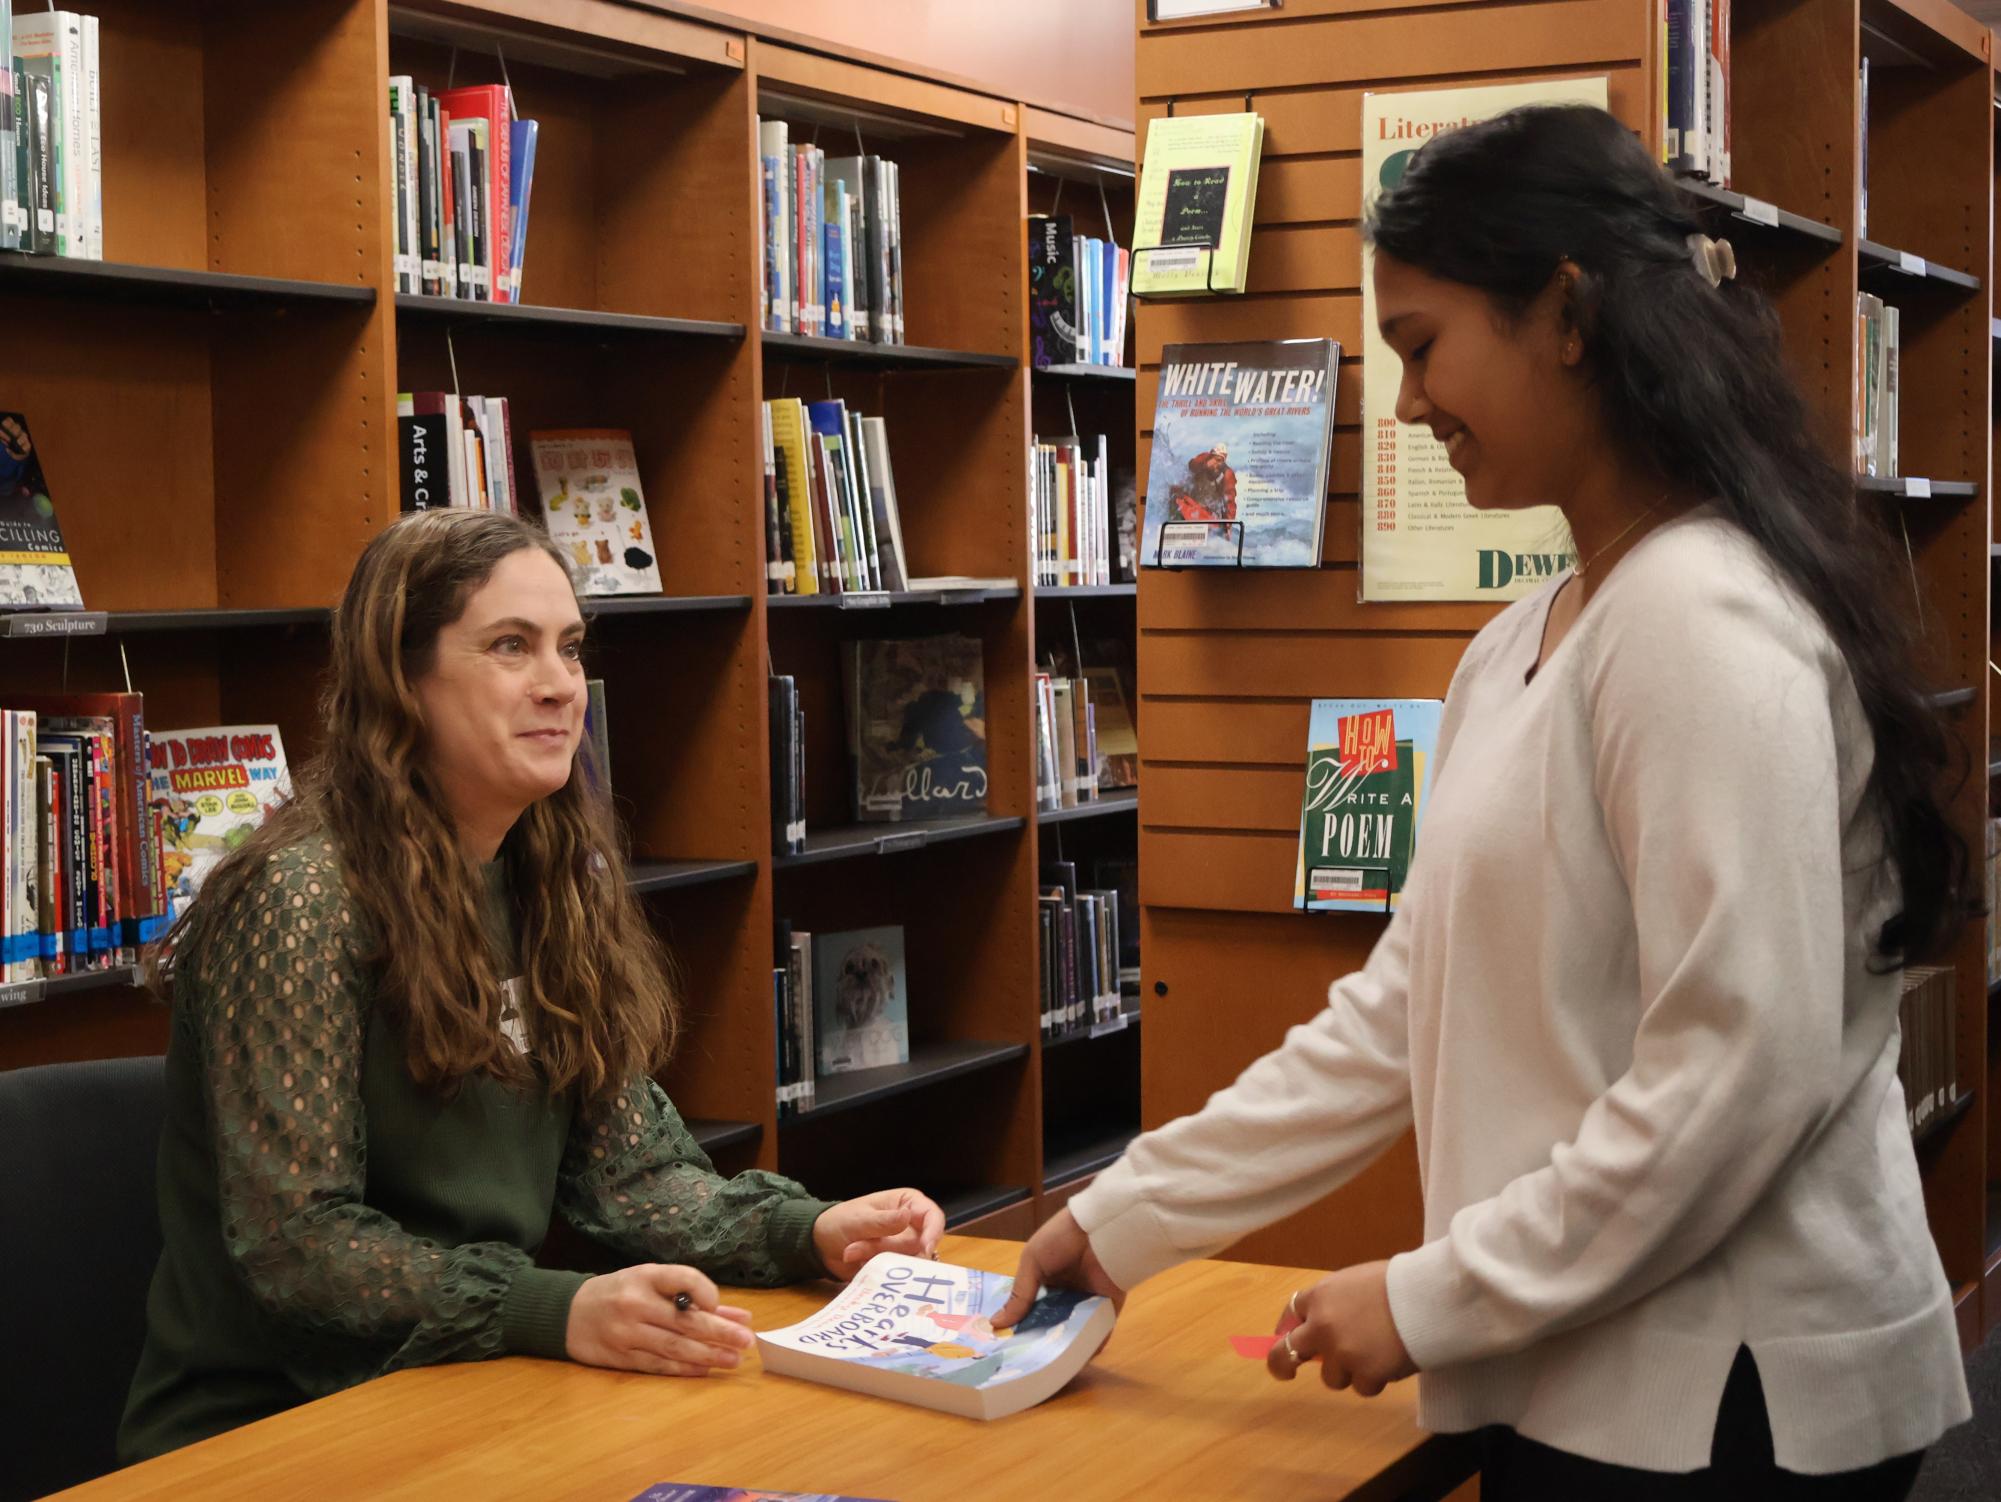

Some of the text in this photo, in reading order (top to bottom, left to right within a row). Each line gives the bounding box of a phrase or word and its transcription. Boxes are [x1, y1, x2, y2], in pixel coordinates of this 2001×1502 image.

[70, 109, 82, 157] Homes
[41, 154, 49, 183] House
[500, 163, 508, 178] OF
[41, 184, 49, 208] Ideas
[1045, 222, 1059, 264] Music
[1163, 361, 1325, 404] WHITE WATER!
[1158, 400, 1169, 408] THE
[1171, 399, 1191, 408] THRILL
[1194, 399, 1207, 408] AND
[1180, 406, 1311, 417] OF RUNNING THE WORLD'S GREAT RIVERS
[1377, 418, 1396, 428] 800
[1377, 430, 1396, 439] 810
[1377, 441, 1396, 451] 820
[1377, 453, 1396, 462] 830
[413, 425, 429, 513] Arts & Cr
[1377, 476, 1396, 485] 850
[1377, 488, 1396, 497] 860
[1377, 499, 1396, 509] 870
[1377, 511, 1396, 520] 880
[1377, 522, 1396, 532] 890
[28, 543, 64, 552] Comics
[1153, 549, 1172, 560] MRK
[1173, 549, 1198, 560] BLAINE
[1475, 549, 1572, 590] DEWE
[24, 618, 96, 634] 730 Sculpture
[1344, 715, 1392, 755] HOW
[186, 734, 229, 767] DRAW
[230, 733, 276, 762] COMICS
[1359, 745, 1376, 771] TO
[175, 768, 246, 789] MARVEL
[248, 767, 277, 781] WAY
[1305, 757, 1412, 811] WRITE A
[132, 714, 150, 886] Masters of American Comics
[1321, 813, 1394, 859] POEM
[0, 988, 27, 1003] wing
[799, 1267, 912, 1344] OVERBOARD
[825, 1275, 954, 1351] Hearts
